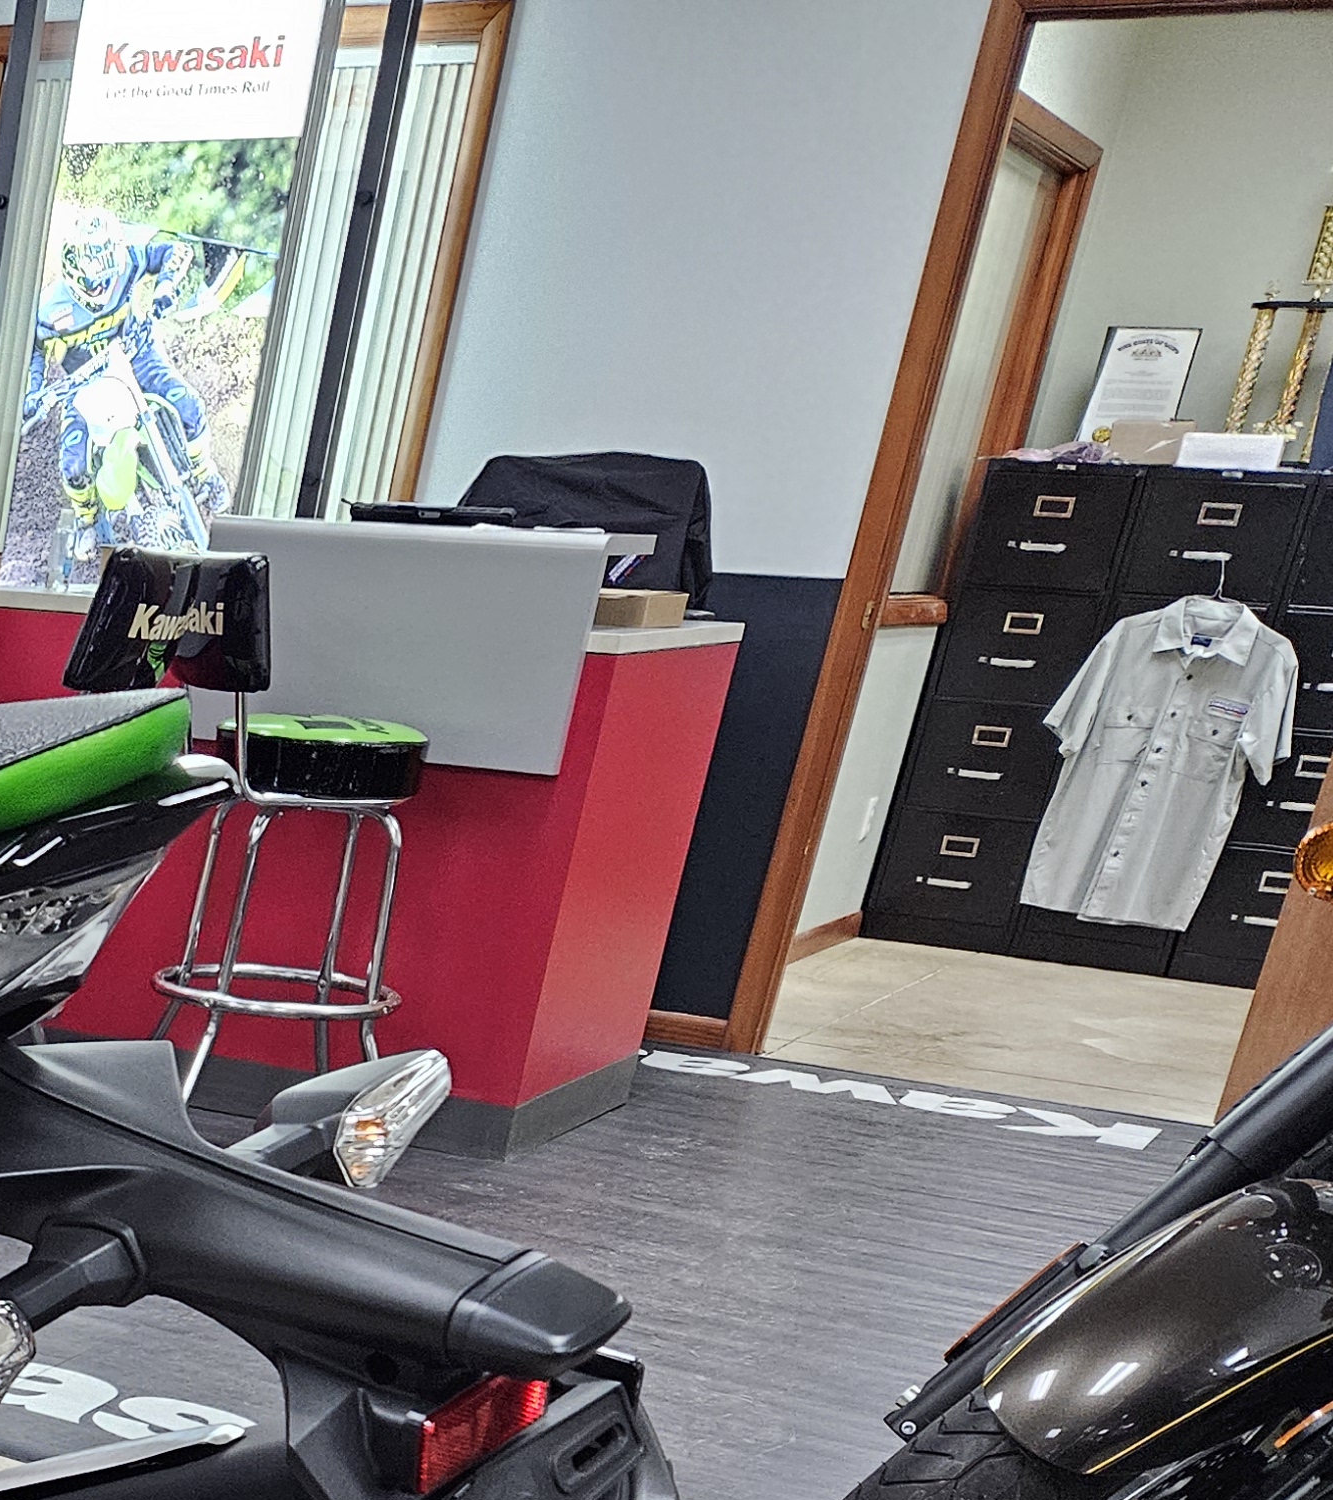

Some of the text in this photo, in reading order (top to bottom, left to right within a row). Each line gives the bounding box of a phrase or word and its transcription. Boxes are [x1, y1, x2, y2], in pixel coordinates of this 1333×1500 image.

[102, 35, 286, 75] Kawasaki
[131, 86, 153, 98] the
[156, 84, 193, 97] Good
[198, 82, 237, 95] Times
[242, 80, 271, 93] Roll
[128, 602, 225, 641] Kawaaki
[637, 1048, 1163, 1151] Kawa
